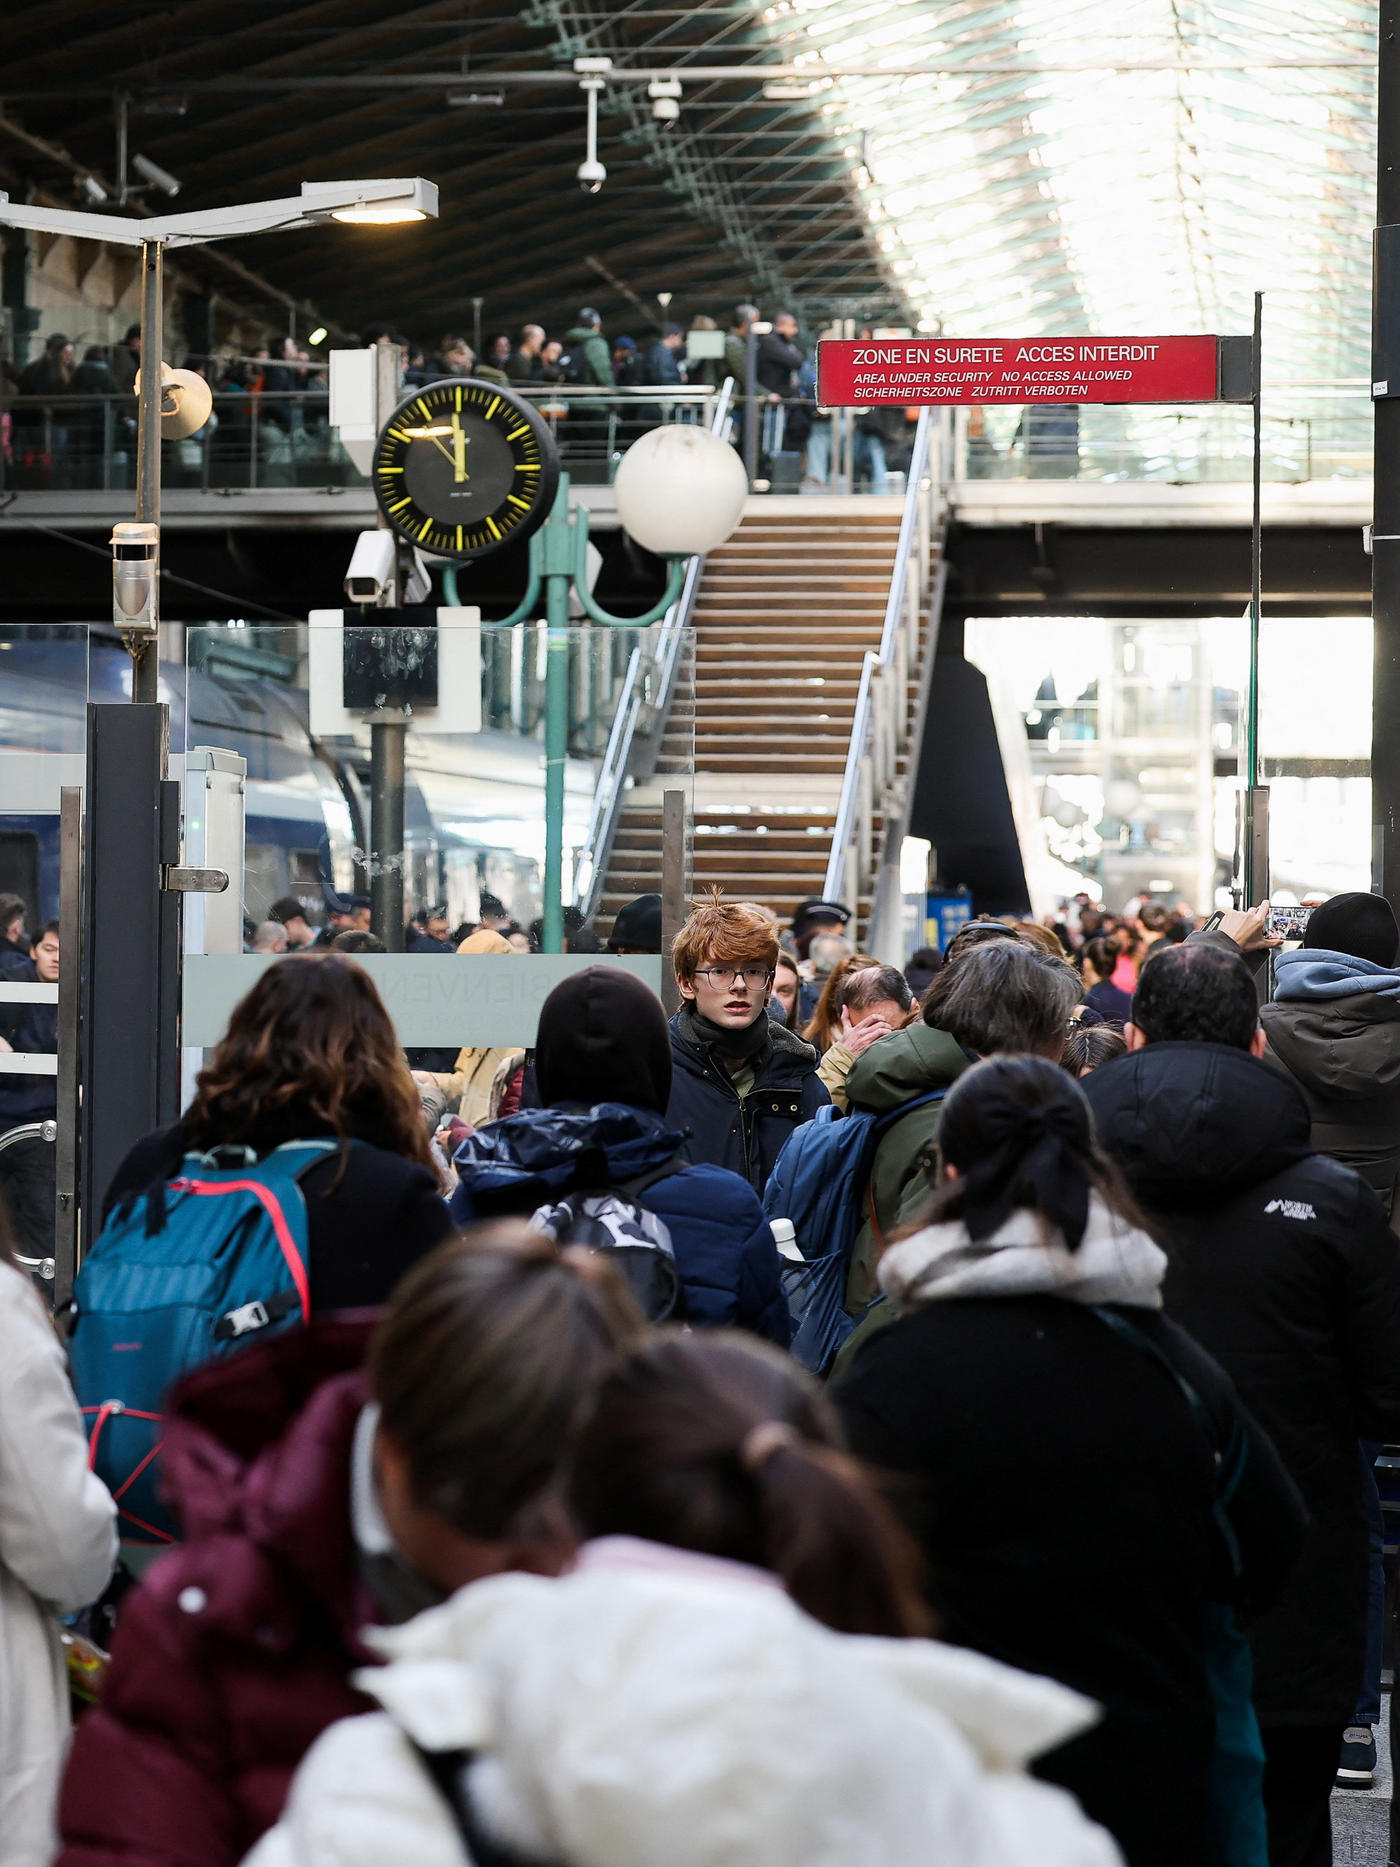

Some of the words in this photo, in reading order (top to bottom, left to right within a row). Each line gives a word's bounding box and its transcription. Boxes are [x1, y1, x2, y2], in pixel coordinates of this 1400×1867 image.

[852, 348, 902, 365] ZONE
[906, 348, 930, 364] EN
[934, 347, 1004, 364] SURETE
[1015, 346, 1075, 363] ACCES
[1079, 345, 1160, 362] INTERDIT
[853, 373, 886, 384] AREA
[889, 372, 932, 384] UNDER
[933, 372, 993, 383] SECURITY
[1001, 371, 1021, 382] NO
[1022, 371, 1070, 382] ACCESS
[1072, 370, 1133, 381] ALLOWED
[853, 386, 964, 398] SICHERHEITSZONE
[970, 385, 1022, 397] ZUTRITT
[1024, 385, 1088, 396] VERBOTEN
